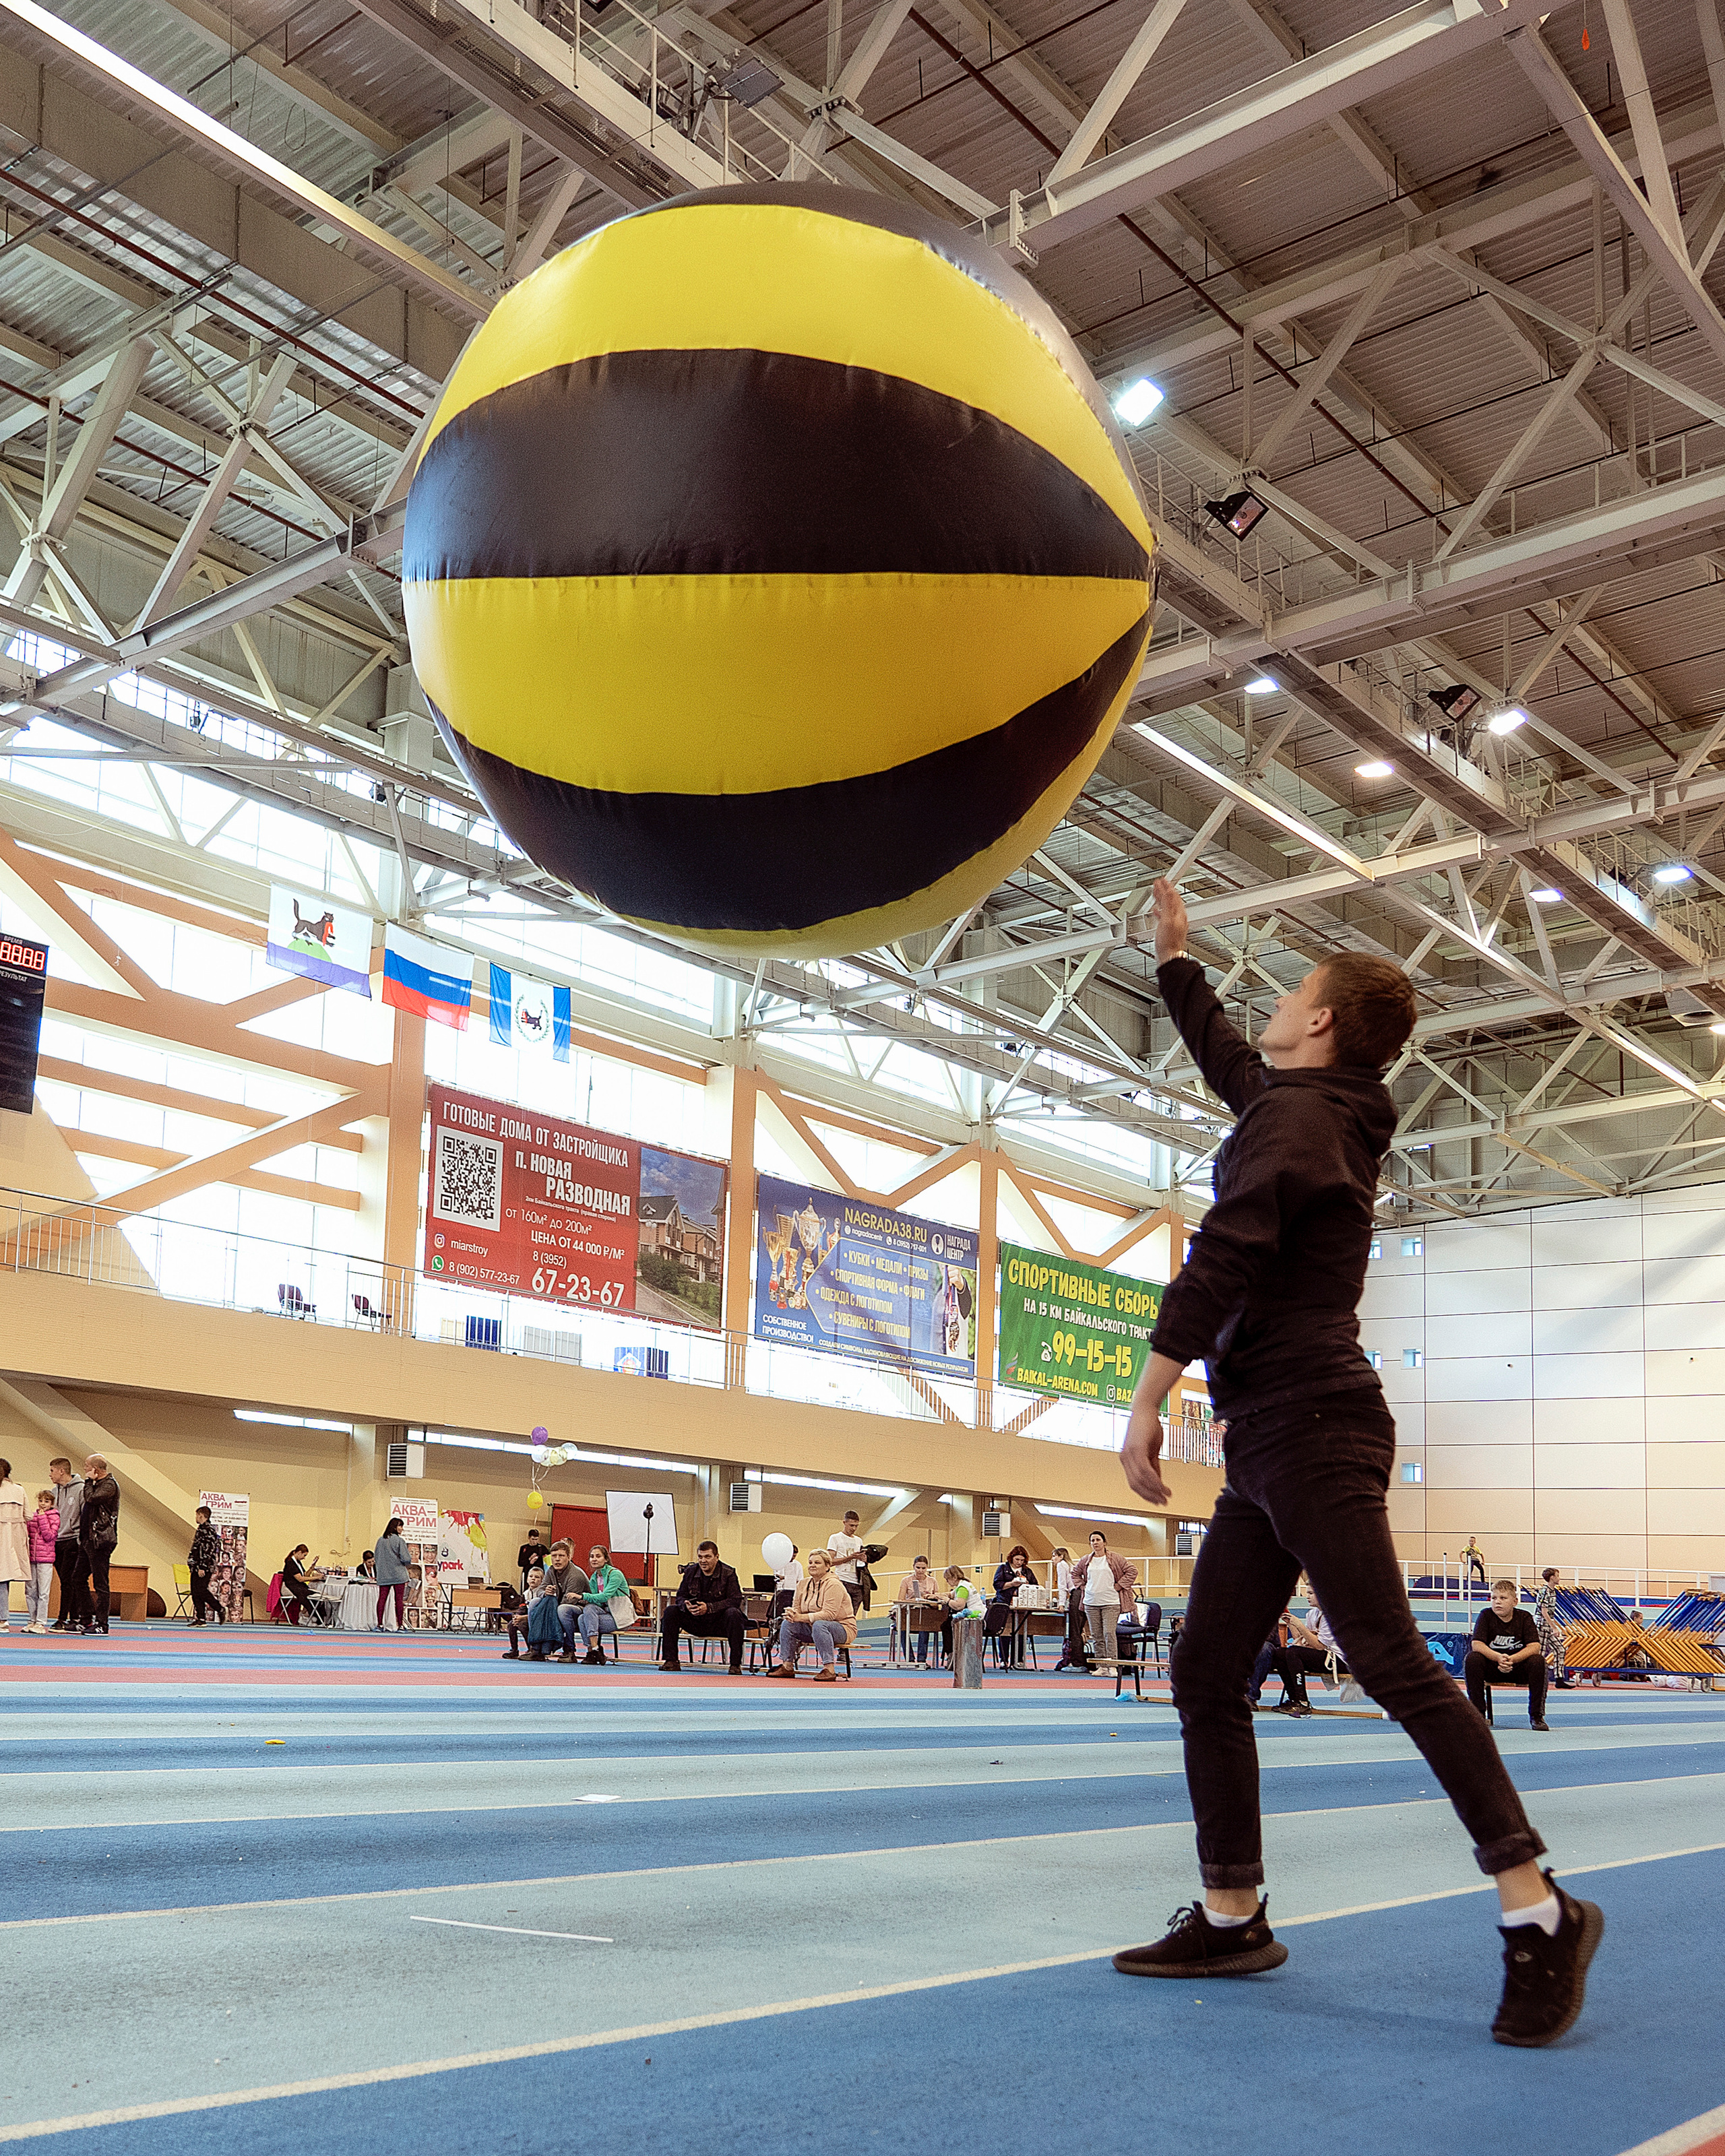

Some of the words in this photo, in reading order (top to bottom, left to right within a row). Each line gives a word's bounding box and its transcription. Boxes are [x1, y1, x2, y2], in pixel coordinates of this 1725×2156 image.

[4, 935, 23, 945] ВРЕМЯ
[443, 1101, 496, 1132] ГОТОВЫЕ
[499, 1117, 532, 1142] ДОМА
[536, 1127, 550, 1147] ОТ
[553, 1131, 629, 1168] ЗАСТРОЙЩИКА
[515, 1151, 527, 1170] П.
[530, 1153, 572, 1180] НОВАЯ
[534, 1197, 565, 1210] Байкальского
[546, 1176, 631, 1216] РАЗВОДНАЯ
[844, 1207, 928, 1243] NAGRADA38.RU
[451, 1240, 489, 1257] miarstroy
[531, 1230, 557, 1246] ЦЕНА
[559, 1236, 571, 1249] ОТ
[573, 1240, 584, 1252] 44
[586, 1242, 602, 1256] 000
[947, 1234, 971, 1252] НАГРАДА
[947, 1247, 964, 1262] ЦЕНТР
[532, 1250, 538, 1261] 8
[540, 1252, 567, 1269] (3952)
[848, 1250, 871, 1267] КУБКИ
[875, 1257, 903, 1275] МЕДАЛИ
[908, 1265, 929, 1281] ПРИЗЫ
[449, 1261, 455, 1272] 8
[457, 1263, 478, 1279] (902)
[480, 1268, 520, 1285] 577-23-67
[835, 1268, 875, 1290] СПОРТИВНАЯ
[875, 1279, 898, 1295] ФОРМА
[904, 1284, 925, 1301] ФЛАГИ
[1008, 1258, 1110, 1308] СПОРТИВНЫЕ
[532, 1267, 625, 1307] 67-23-67
[820, 1286, 850, 1306] ОДЕЖДА
[850, 1294, 855, 1306] С
[855, 1294, 893, 1314] ЛОГОТИПОМ
[762, 1314, 807, 1331] СОБСТВЕННОЕ
[834, 1311, 869, 1331] СУВЕНИРЫ
[869, 1319, 874, 1331] С
[874, 1320, 911, 1339] ЛОГОТИПОМ
[1024, 1297, 1036, 1314] НА
[1039, 1302, 1047, 1317] 15
[1049, 1304, 1062, 1321] КМ
[1064, 1307, 1127, 1335] БАЙКАЛЬСКОГО
[1129, 1323, 1154, 1341] ТРАКТ
[762, 1325, 814, 1343] ПРОИЗВОДСТВО!
[1053, 1331, 1133, 1378] 99-15-15
[1017, 1368, 1098, 1397] BAIKAL-ARENA.COM
[201, 1493, 225, 1501] АКВА
[206, 1500, 232, 1509] ГРИМ
[392, 1504, 427, 1516] АКВА
[437, 1559, 464, 1572] ypark
[1493, 1635, 1515, 1645] NIKE
